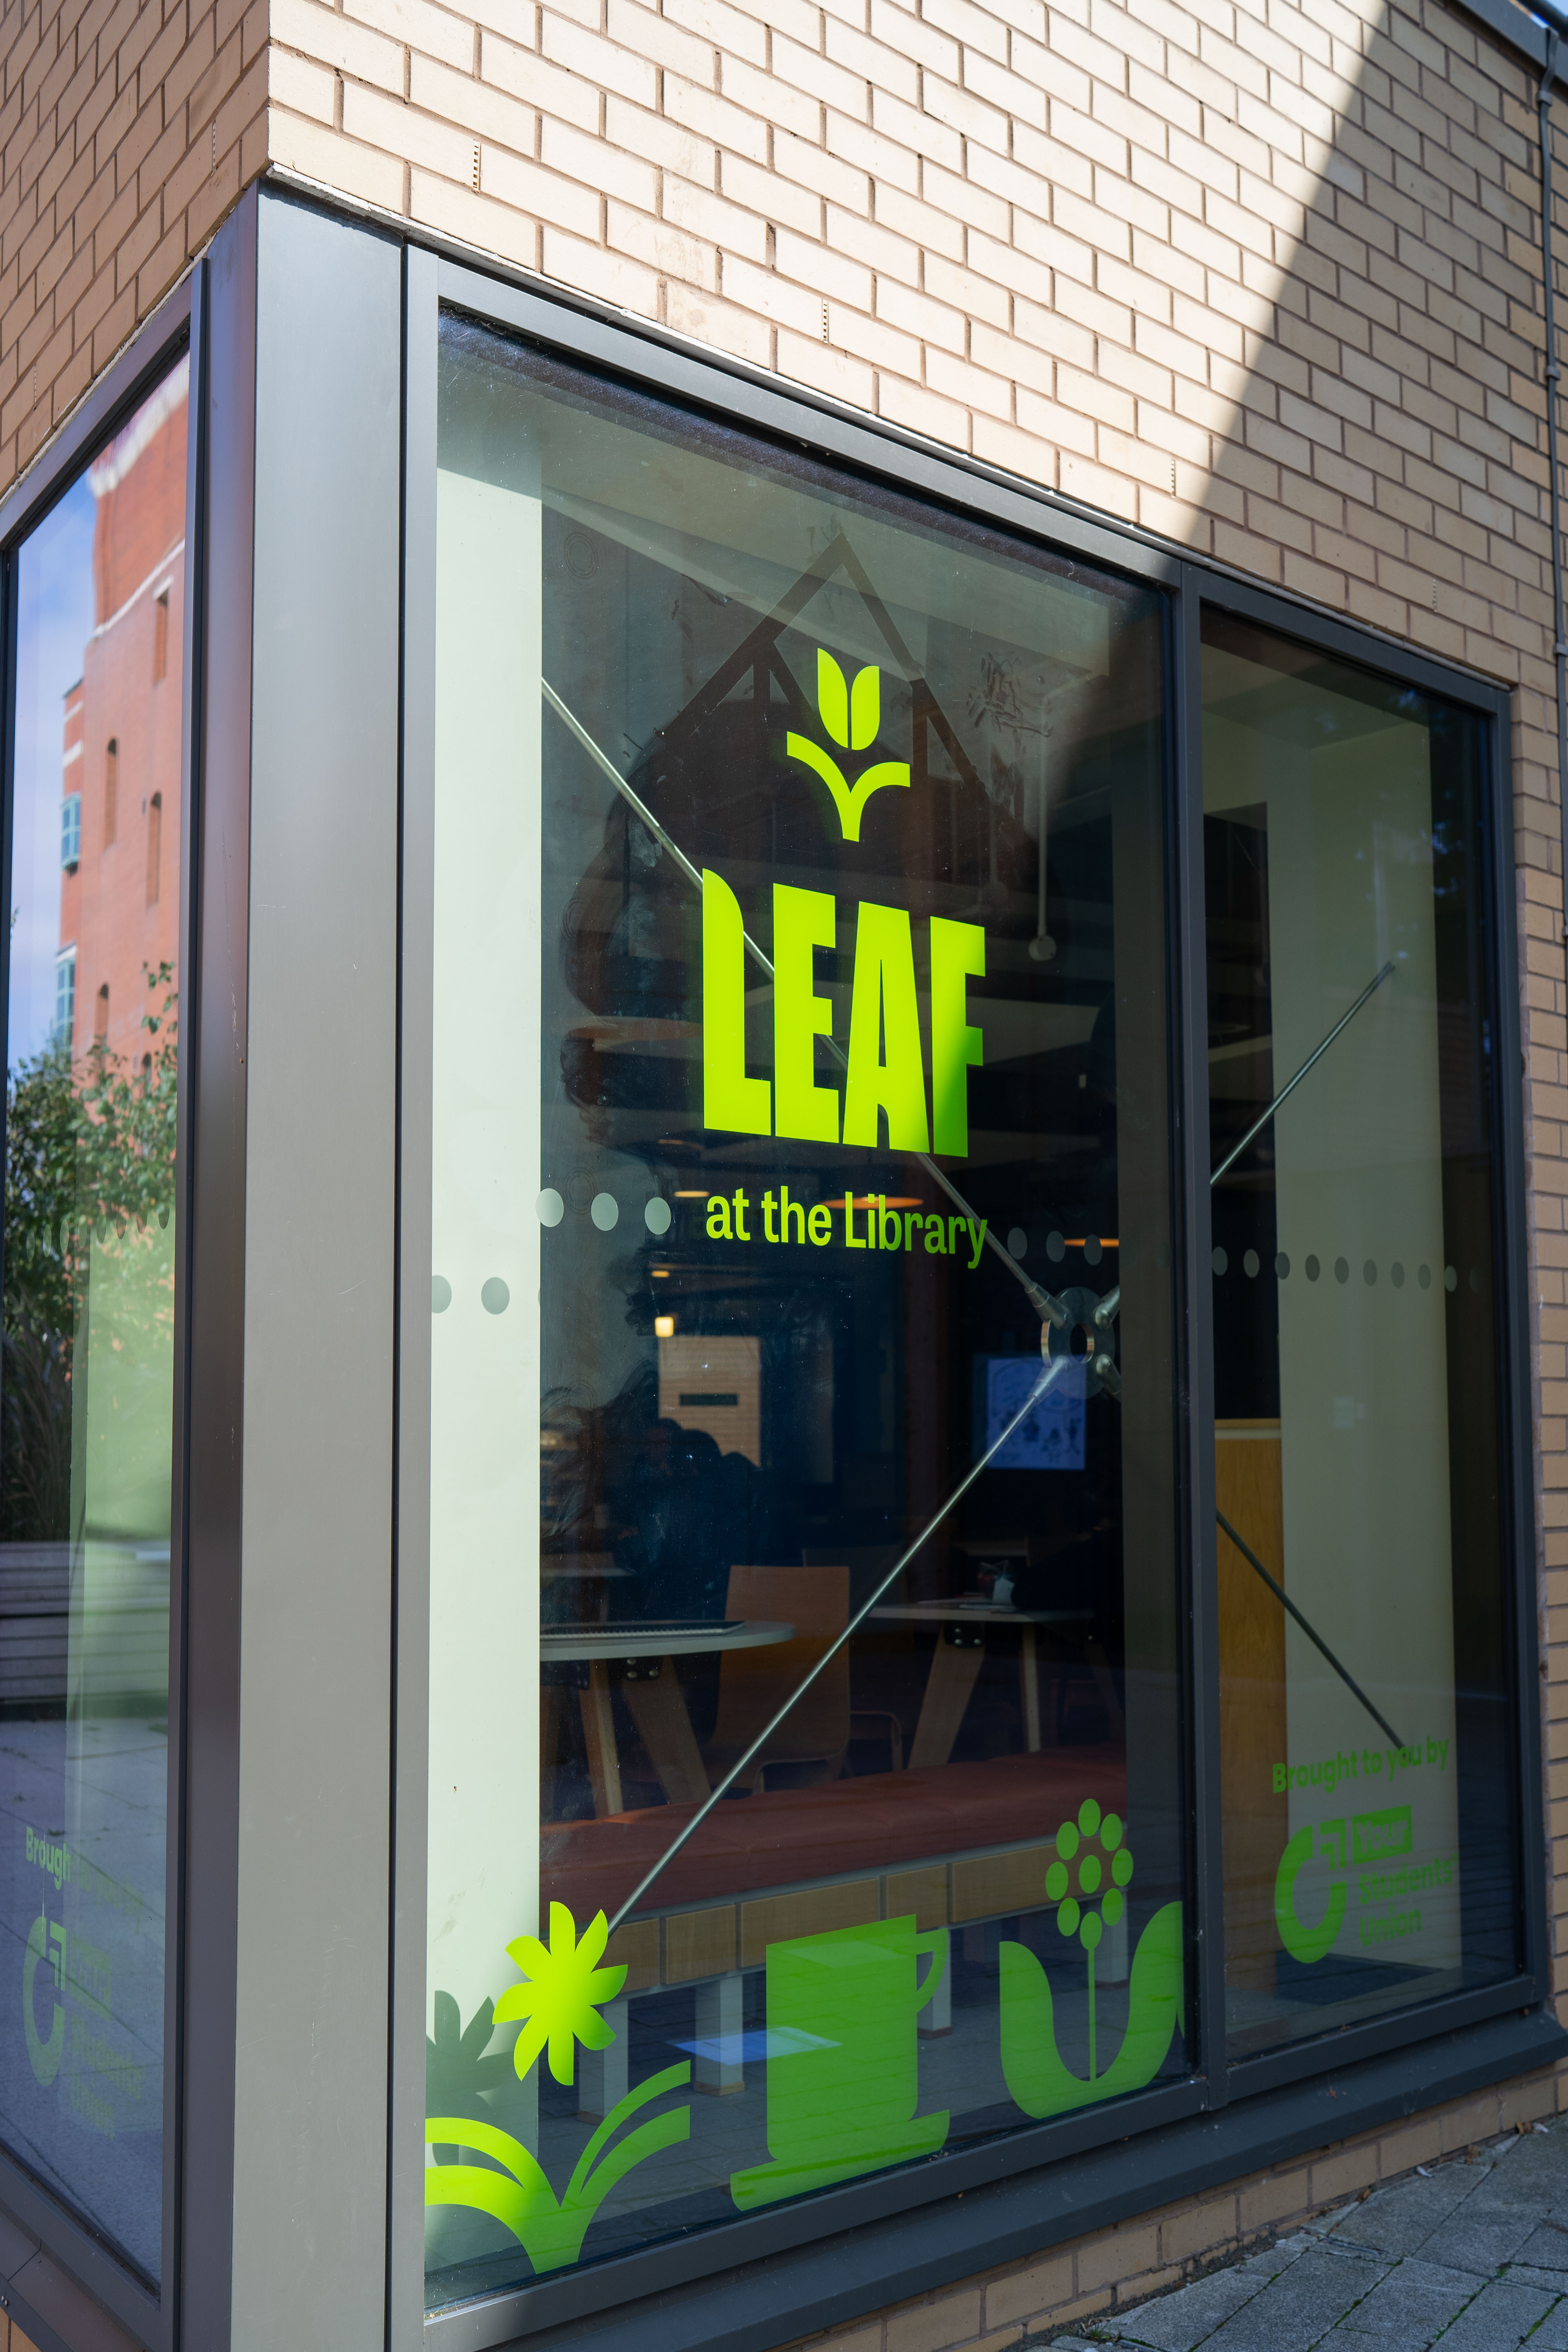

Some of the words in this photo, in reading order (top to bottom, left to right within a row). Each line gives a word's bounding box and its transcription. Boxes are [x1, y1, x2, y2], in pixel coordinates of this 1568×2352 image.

[703, 868, 985, 1158] LEAF
[706, 1187, 750, 1241] at
[761, 1185, 832, 1246] the
[845, 1191, 987, 1269] Library
[1273, 1750, 1357, 1793] Brought
[1363, 1749, 1382, 1775] to
[1386, 1744, 1421, 1781] you
[1426, 1736, 1450, 1771] by
[1356, 1820, 1407, 1853] Your
[1359, 1904, 1421, 1947] Union
